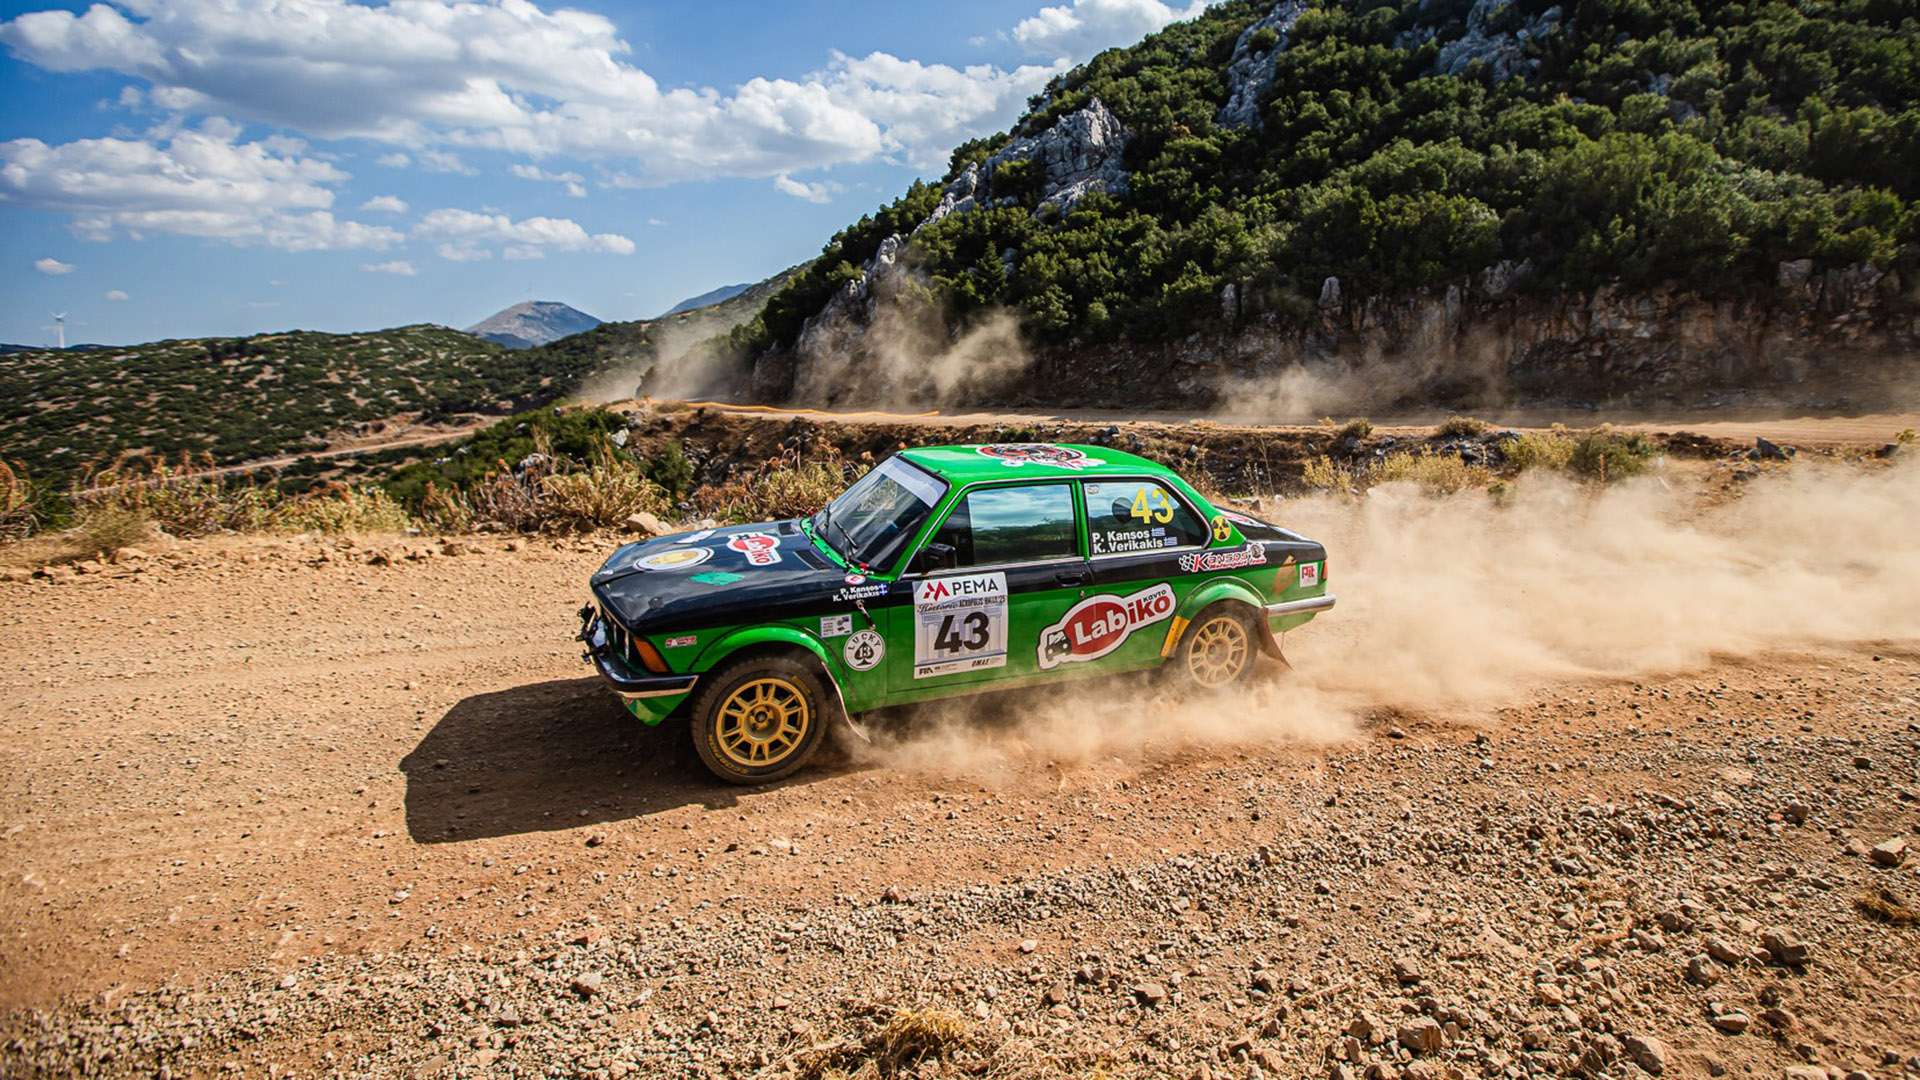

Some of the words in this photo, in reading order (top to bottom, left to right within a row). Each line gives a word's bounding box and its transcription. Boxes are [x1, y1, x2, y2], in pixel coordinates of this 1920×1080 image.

[1131, 487, 1174, 524] 43
[1092, 533, 1104, 543] P.
[1107, 530, 1150, 541] Kansos
[1093, 543, 1106, 554] K.
[850, 585, 879, 594] Kansos
[952, 578, 999, 596] PEMA
[1074, 595, 1171, 646] Labiko
[934, 611, 990, 654] 43
[847, 633, 881, 651] LUCKY
[919, 665, 934, 675] FIA
